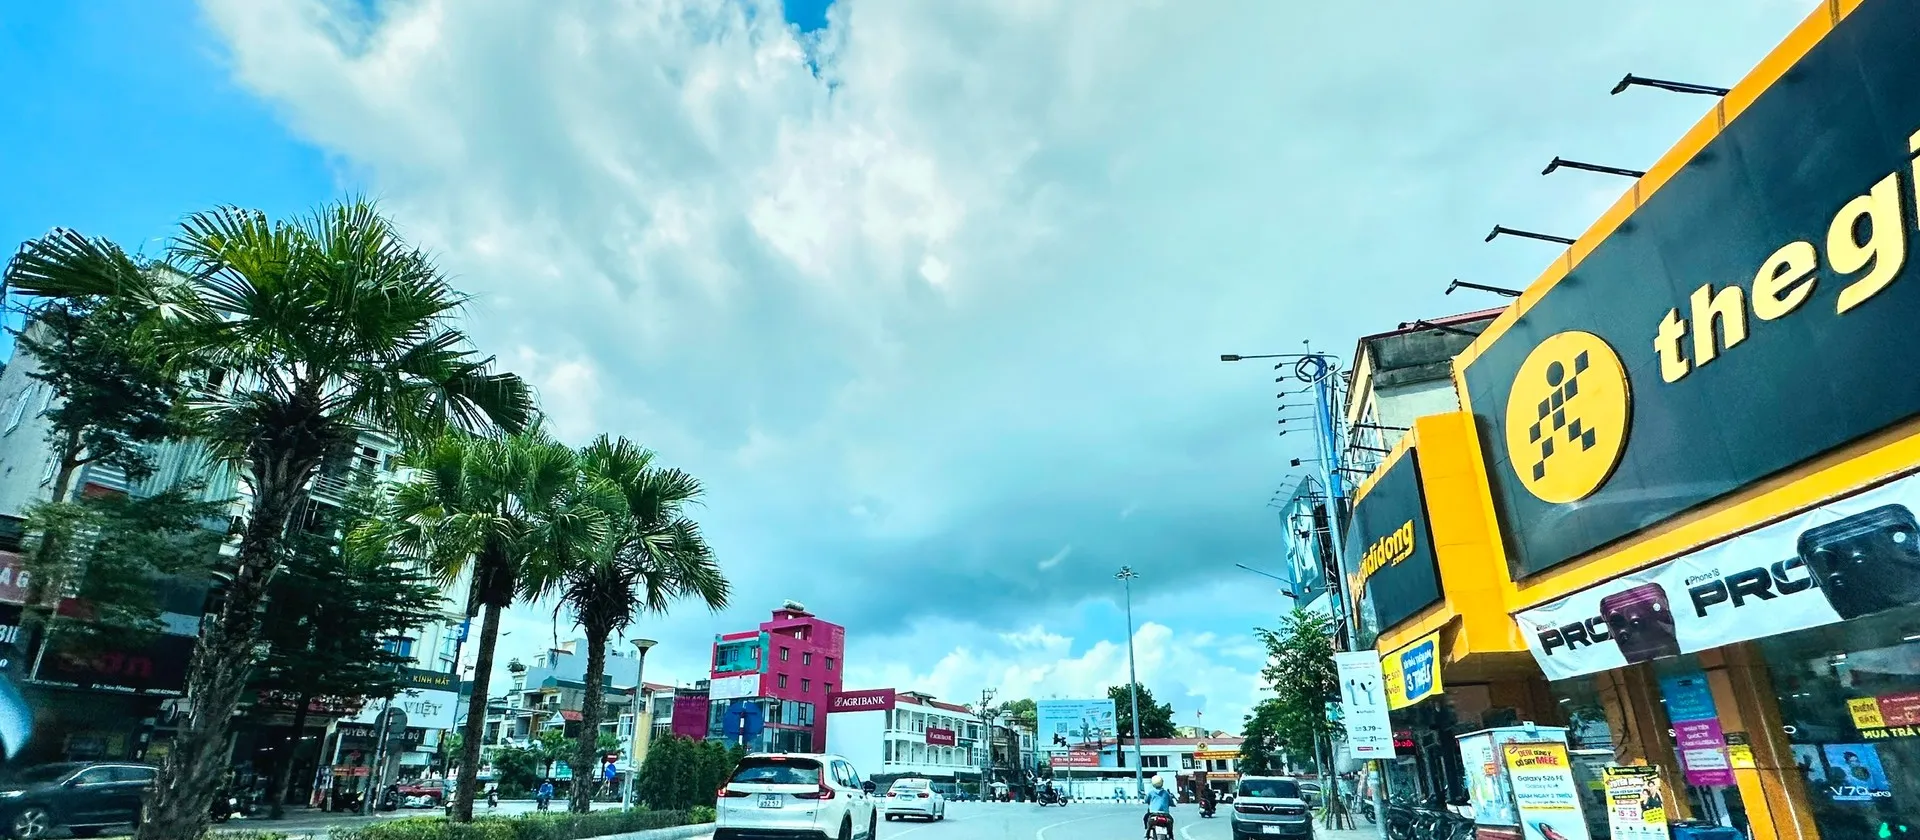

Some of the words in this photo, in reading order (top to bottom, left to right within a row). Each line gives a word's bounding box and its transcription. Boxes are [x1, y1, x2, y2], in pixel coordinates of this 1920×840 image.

[413, 673, 432, 683] KÍNH
[842, 695, 885, 707] AGRIBANK
[404, 700, 443, 718] VIỆT
[1862, 729, 1890, 739] MUA
[1890, 724, 1917, 738] TRẢ
